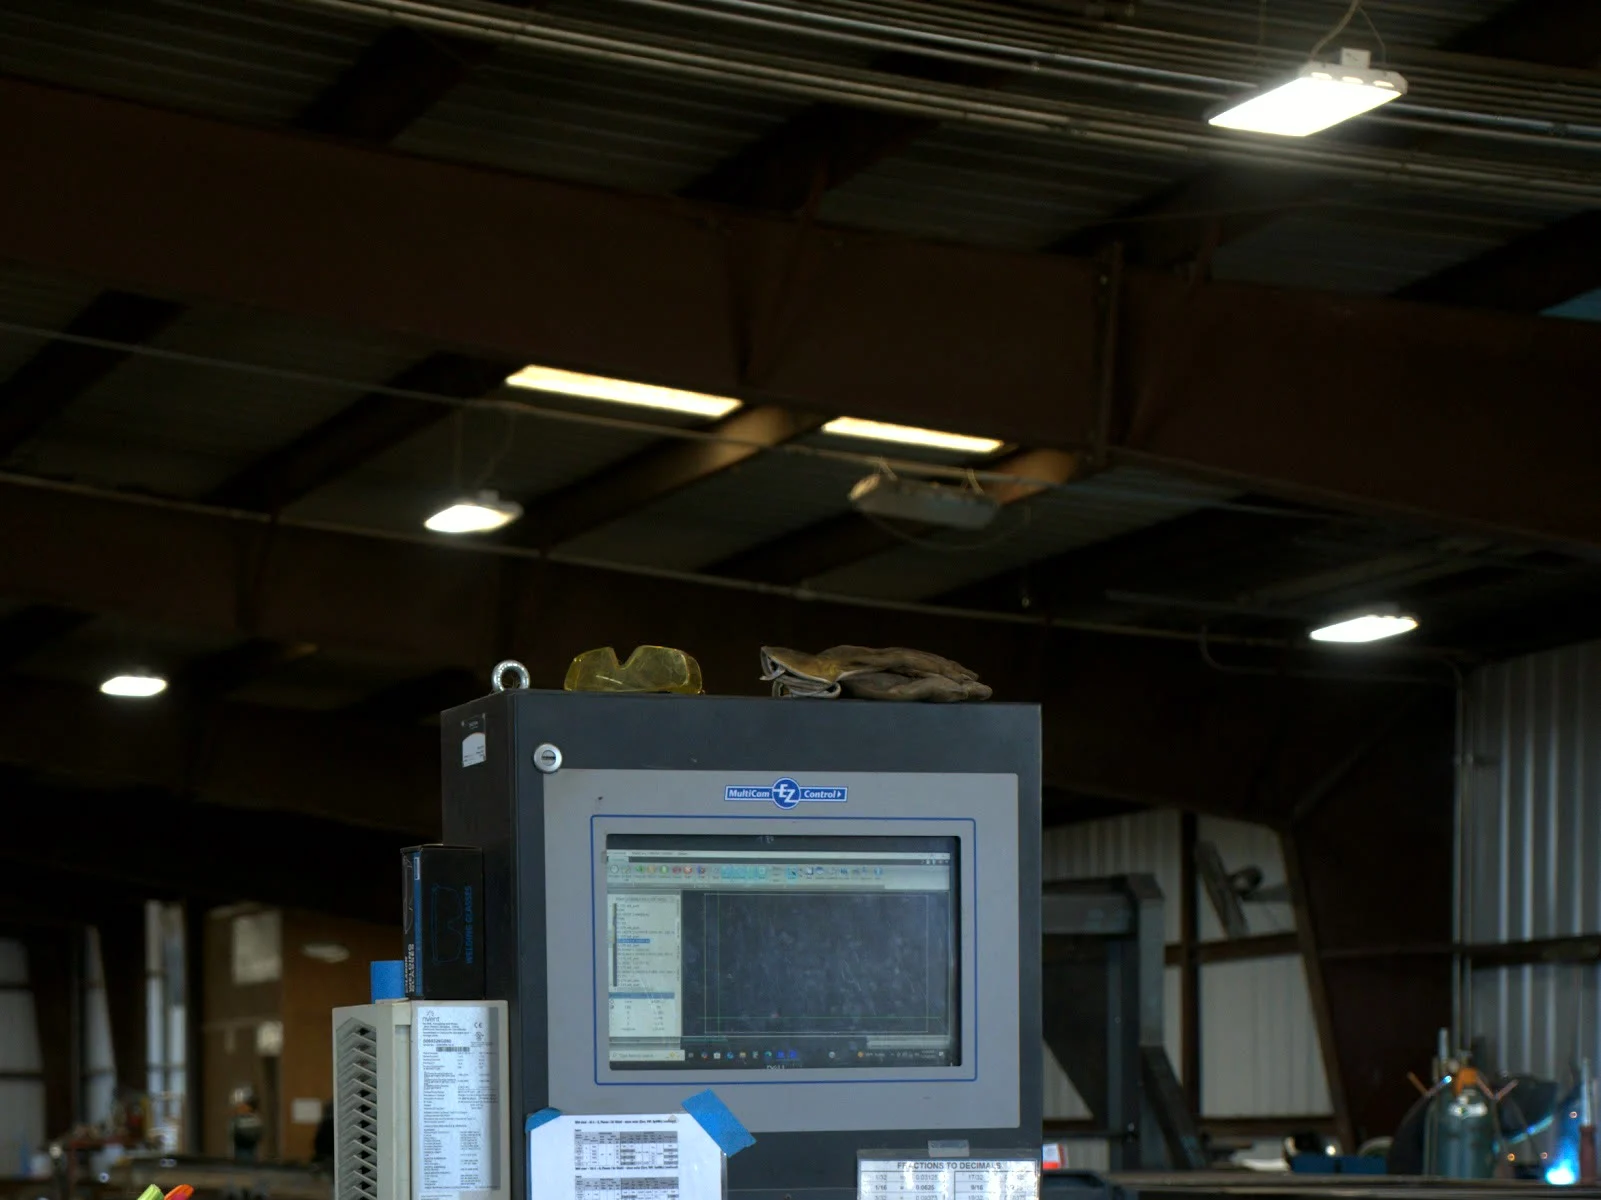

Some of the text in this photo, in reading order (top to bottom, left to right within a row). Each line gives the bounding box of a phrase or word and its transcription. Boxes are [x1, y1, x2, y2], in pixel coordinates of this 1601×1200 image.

[729, 783, 836, 803] MultiCam EZ Control
[464, 885, 474, 964] WELDING GLASSES
[947, 1162, 957, 1170] TO
